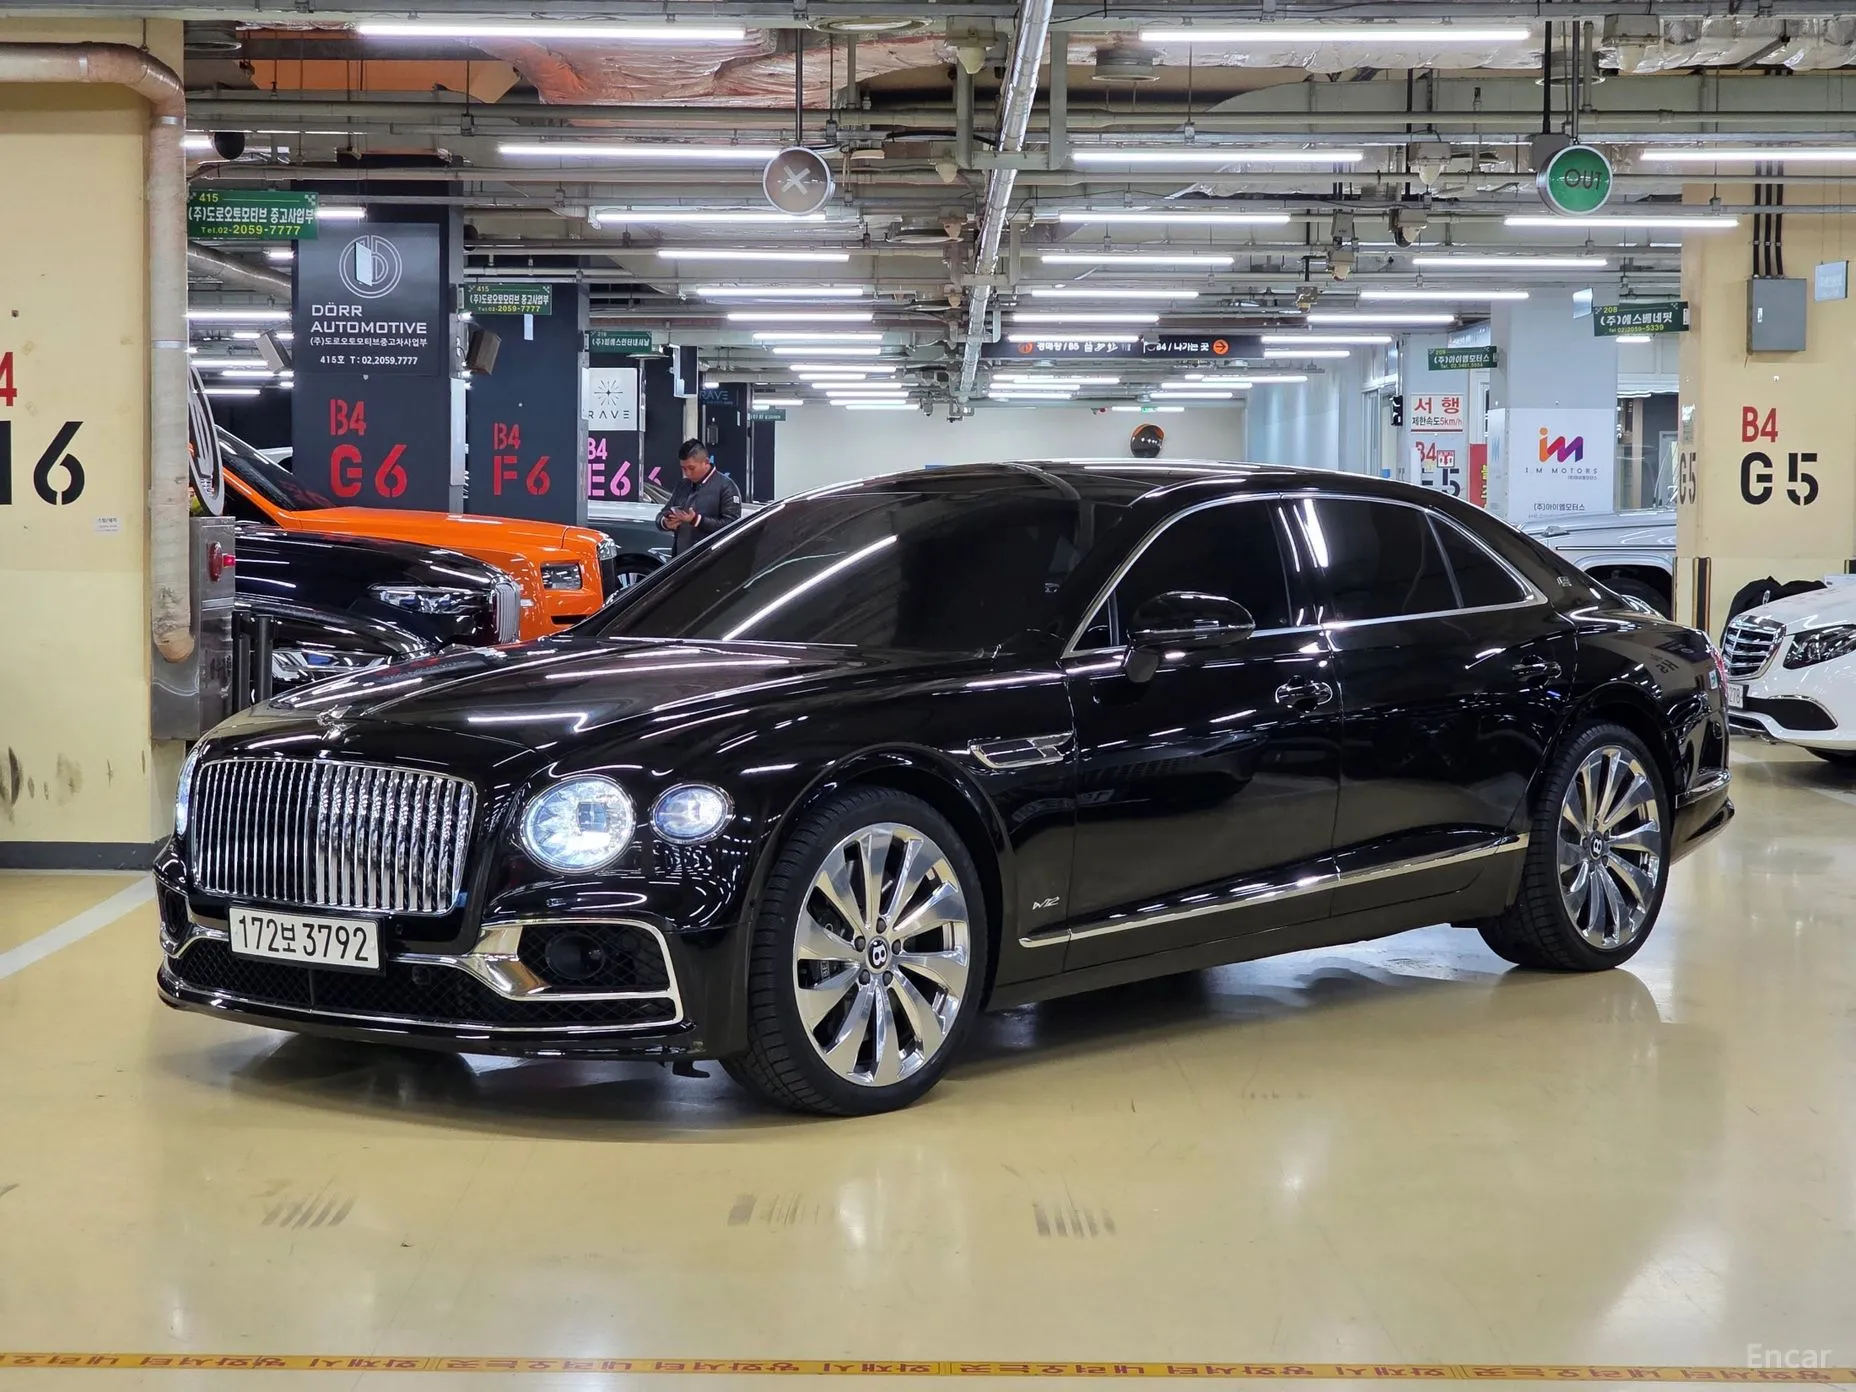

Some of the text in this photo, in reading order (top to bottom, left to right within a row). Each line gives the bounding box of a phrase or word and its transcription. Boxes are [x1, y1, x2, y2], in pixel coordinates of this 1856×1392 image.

[1564, 168, 1602, 190] OUT
[199, 193, 219, 202] 415
[188, 206, 315, 224] (주)도로오토모티브 중고사업부
[311, 302, 362, 316] DÖRR
[310, 321, 428, 334] AUTOMOTIVE
[1173, 342, 1198, 351] 나가는
[320, 355, 345, 364] 415호
[329, 399, 366, 436] B4
[588, 410, 630, 419] RAVE
[1742, 406, 1779, 443] B4
[493, 423, 521, 450] B4
